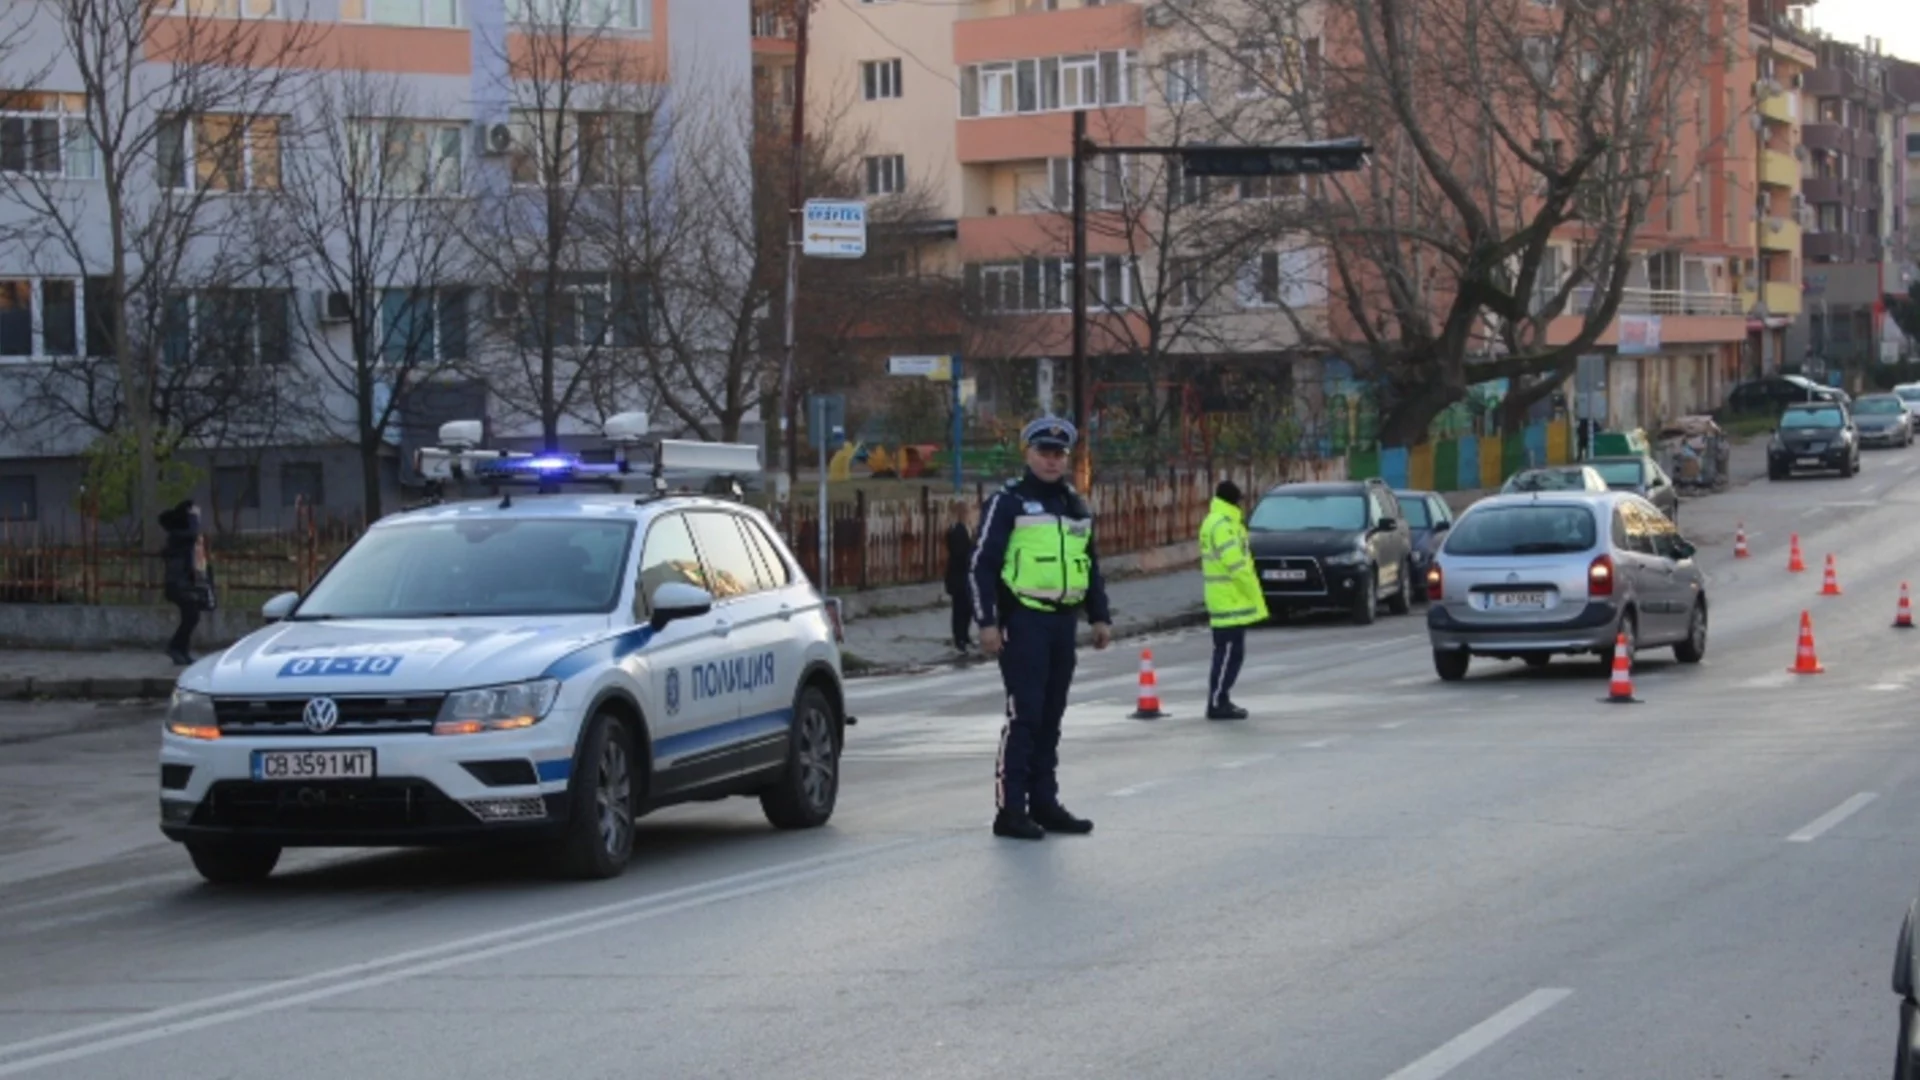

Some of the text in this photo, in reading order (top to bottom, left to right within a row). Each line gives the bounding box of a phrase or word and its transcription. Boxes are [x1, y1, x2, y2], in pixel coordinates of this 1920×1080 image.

[291, 655, 394, 674] 01-10
[691, 651, 775, 701] ПОЛИЦИЯ
[291, 752, 339, 775] 3591
